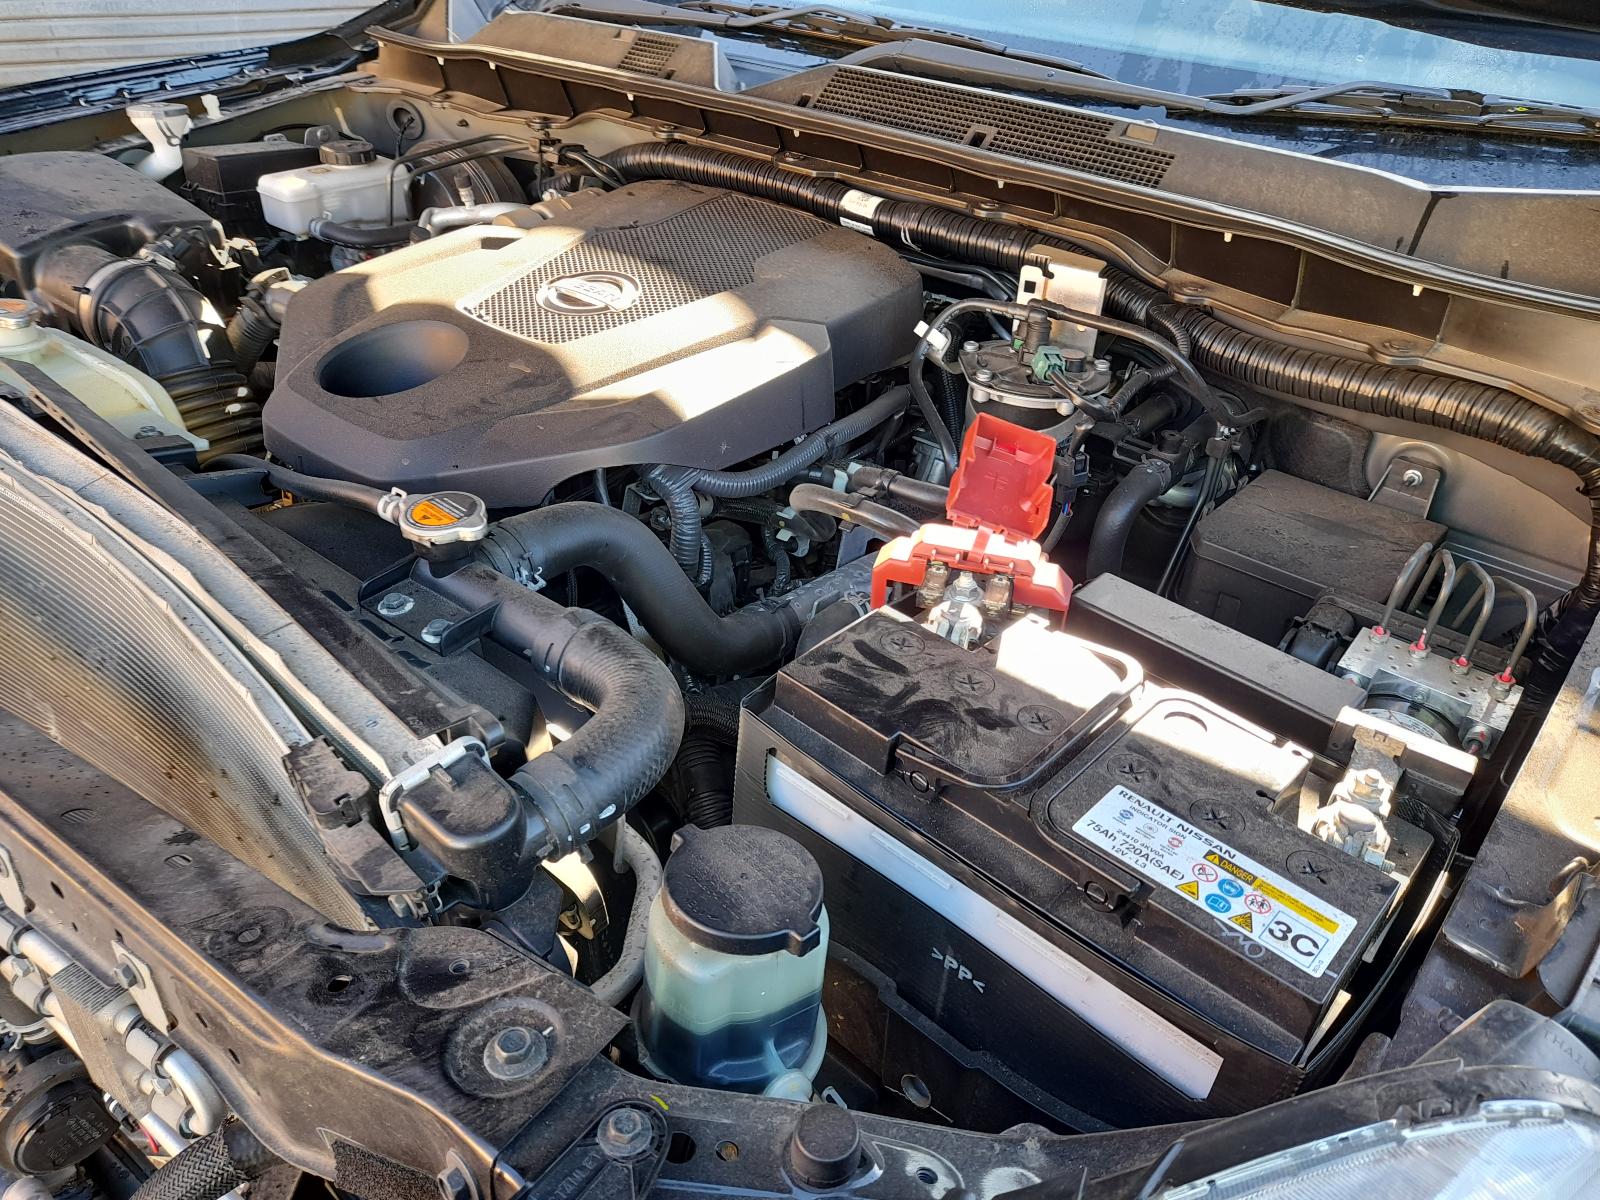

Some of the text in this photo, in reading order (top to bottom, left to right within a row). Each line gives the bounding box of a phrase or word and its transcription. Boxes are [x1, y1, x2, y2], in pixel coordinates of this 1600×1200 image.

[1118, 789, 1237, 860] RENAULT NISSAN
[1129, 805, 1168, 830] INDICATOR
[1169, 827, 1187, 840] SIGN
[1086, 819, 1117, 842] 75Ah
[1120, 839, 1186, 881] 720A(SAE)
[1111, 845, 1129, 857] 12V
[1134, 858, 1147, 869] L3
[1220, 859, 1254, 884] DANGER
[1267, 920, 1320, 957] 3C
